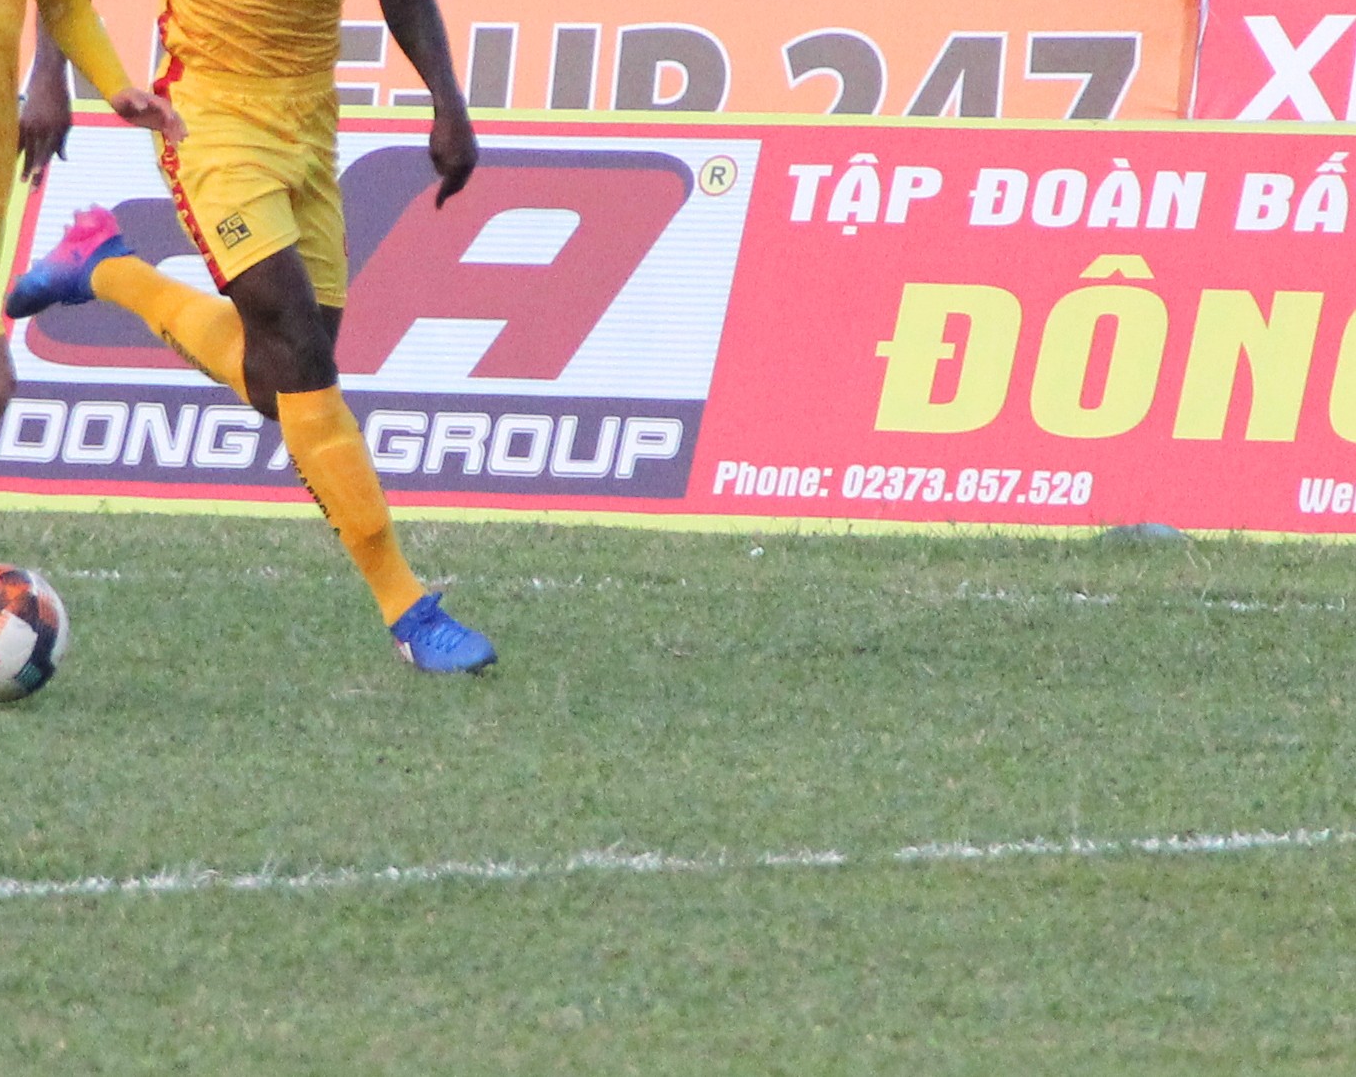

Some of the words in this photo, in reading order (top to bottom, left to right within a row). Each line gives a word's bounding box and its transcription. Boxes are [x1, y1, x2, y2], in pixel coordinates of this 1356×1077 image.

[787, 152, 943, 236] TẬP
[969, 157, 1207, 230] ĐOÀN
[363, 409, 684, 480] GROUP
[712, 460, 833, 498] Phone:
[841, 464, 1094, 507] 02373.857.528
[1298, 476, 1356, 515] We
